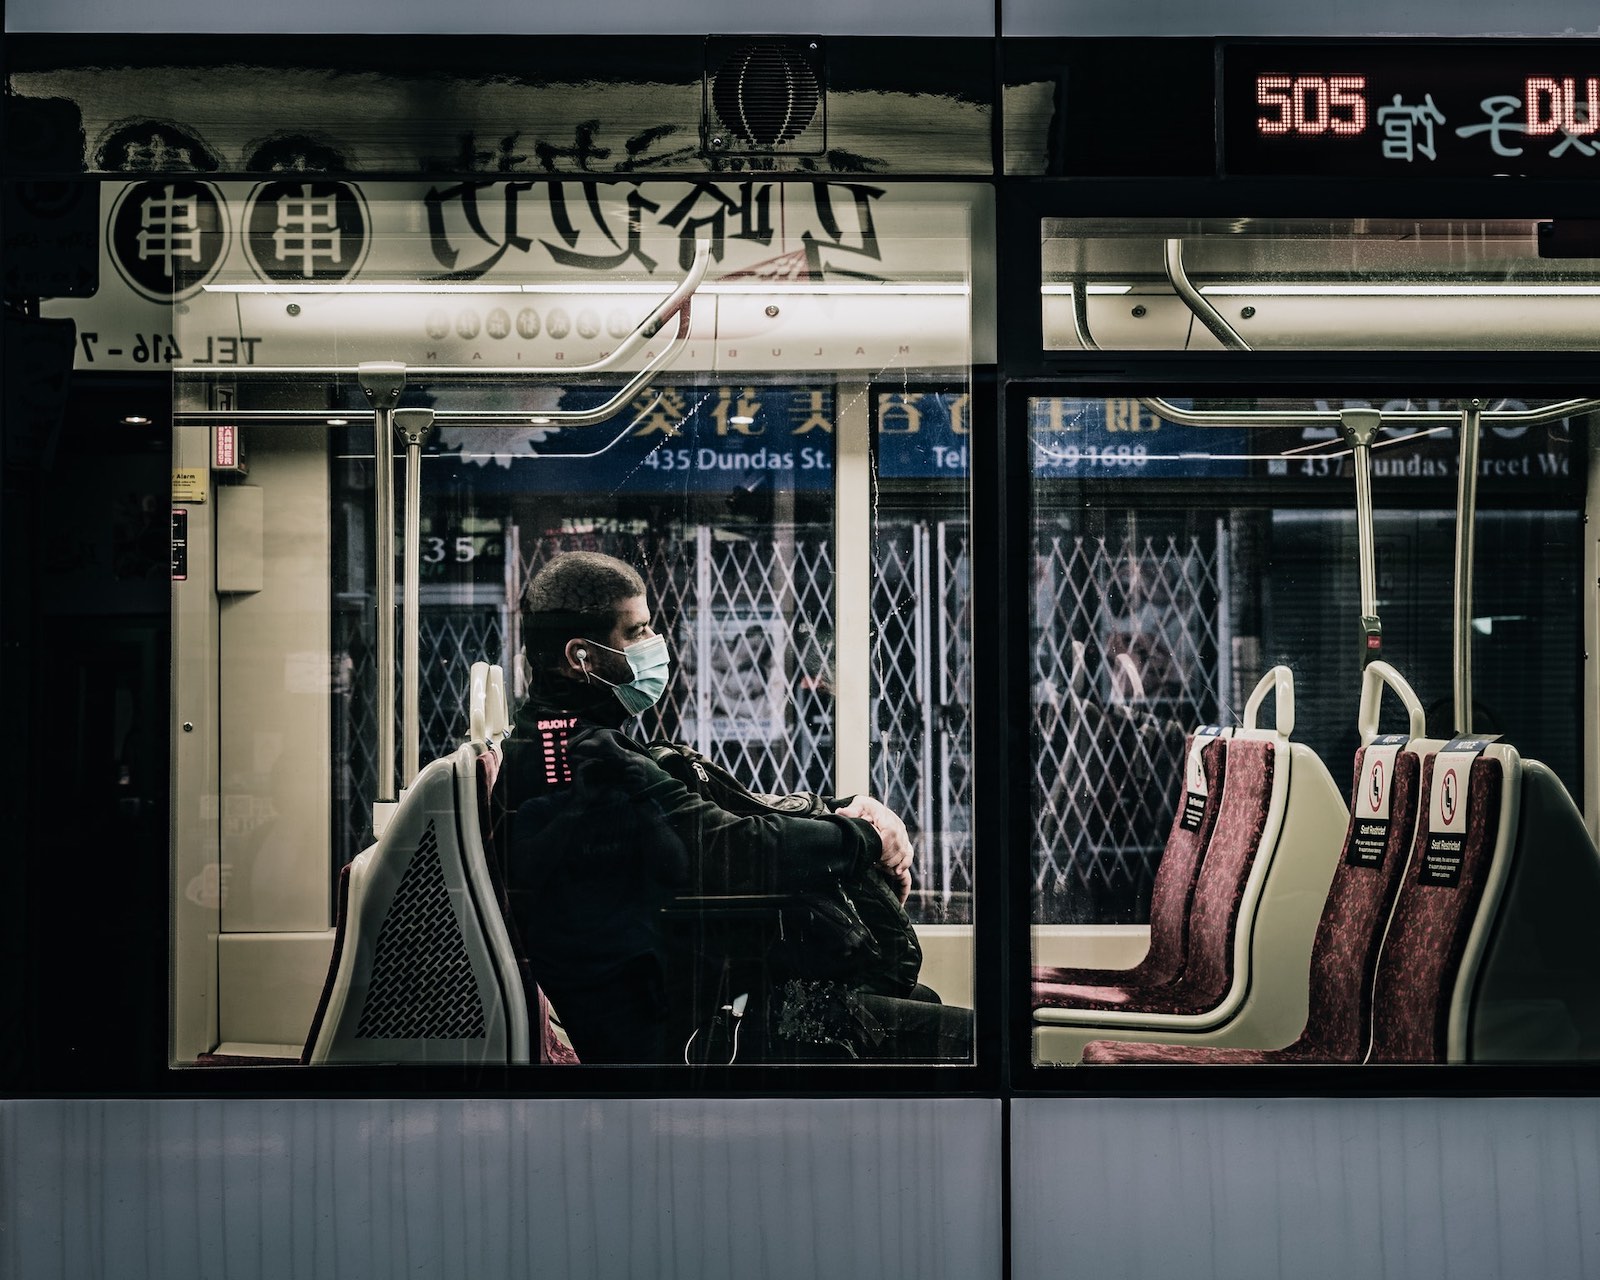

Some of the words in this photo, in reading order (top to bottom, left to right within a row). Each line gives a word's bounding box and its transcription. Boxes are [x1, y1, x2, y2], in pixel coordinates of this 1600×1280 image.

[1256, 75, 1367, 136] 505
[224, 426, 233, 465] AMMER
[645, 448, 691, 470] 435
[698, 447, 794, 470] Dundas
[800, 448, 831, 470] St.
[1300, 456, 1344, 477] 437
[1370, 453, 1449, 477] undas
[1457, 452, 1530, 477] reet
